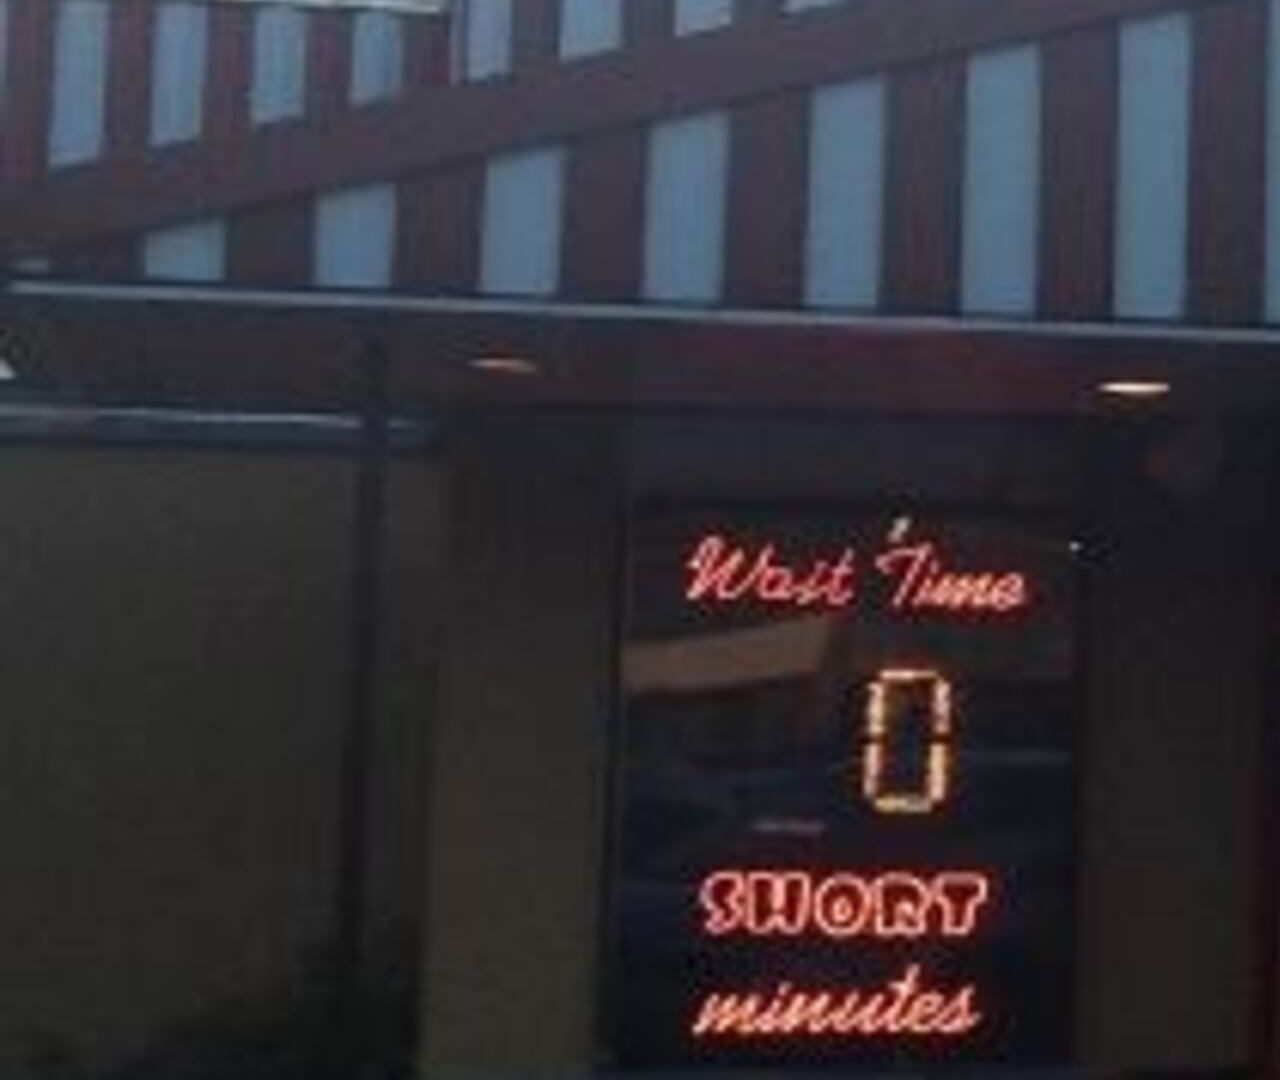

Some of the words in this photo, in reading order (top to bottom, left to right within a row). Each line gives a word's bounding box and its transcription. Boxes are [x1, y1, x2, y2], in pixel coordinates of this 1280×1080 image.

[684, 534, 856, 607] Wait
[874, 540, 1028, 612] Time
[862, 667, 953, 813] 0
[700, 870, 989, 938] SHORT
[691, 962, 982, 1035] minutes
